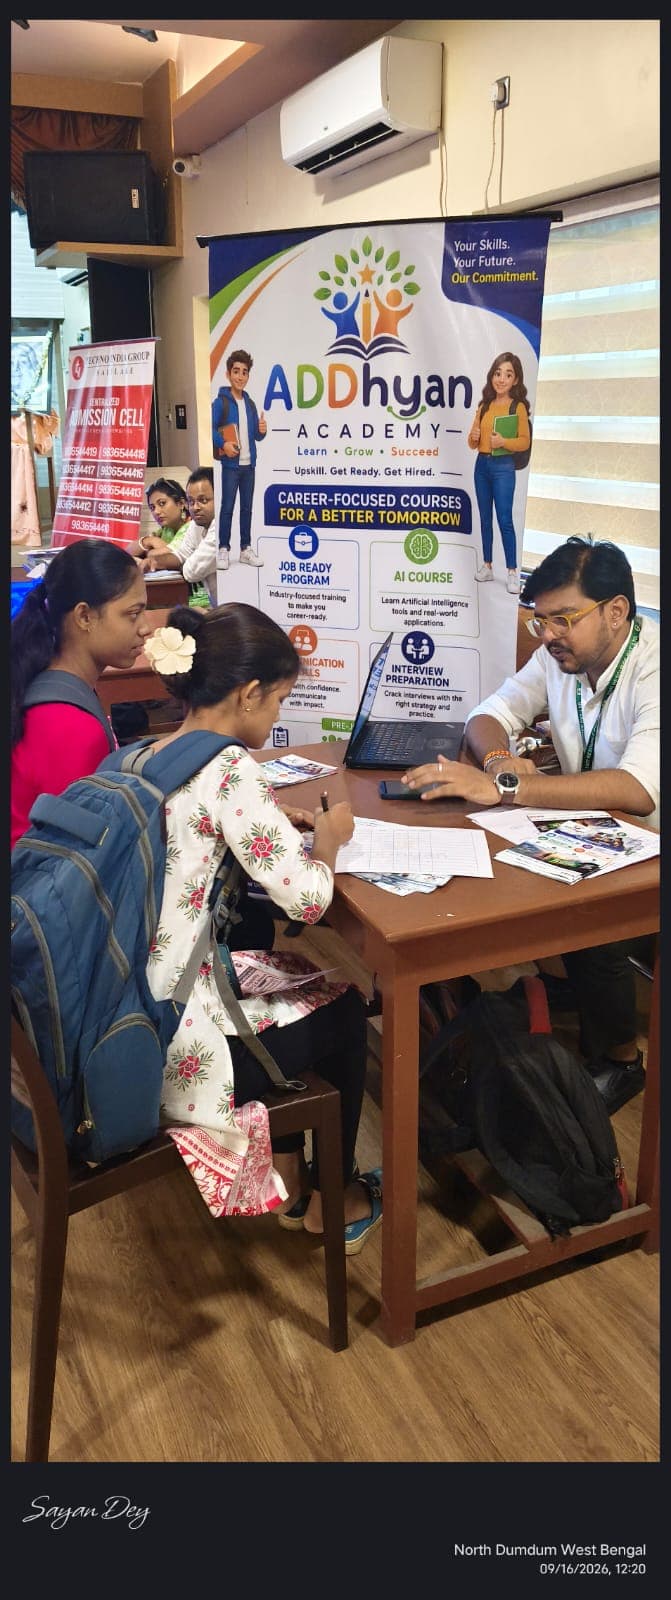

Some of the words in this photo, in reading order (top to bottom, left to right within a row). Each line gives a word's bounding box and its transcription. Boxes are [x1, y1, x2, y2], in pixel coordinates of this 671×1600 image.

[454, 240, 476, 251] Your
[479, 238, 511, 250] Skills.
[454, 257, 475, 268] Your
[478, 255, 516, 267] Future.
[451, 272, 470, 284] Our
[472, 270, 539, 283] Commitment.
[263, 362, 473, 417] ADDhyan
[119, 408, 145, 427] CELL
[297, 423, 441, 439] ACADEMY
[297, 446, 328, 457] Learn
[344, 446, 374, 457] Grow
[391, 446, 439, 457] Succeed
[294, 466, 327, 477] Upskill.
[330, 466, 347, 476] Get
[350, 466, 381, 478] Ready.
[384, 467, 402, 476] Get
[405, 467, 435, 477] Hired.
[278, 491, 396, 508] CAREER-FOCUSED
[400, 493, 462, 510] COURSES
[280, 508, 305, 521] FOR
[308, 508, 318, 522] A
[321, 509, 374, 523] BETTER
[378, 510, 461, 526] TOMORROW
[278, 560, 296, 572] JOB
[299, 561, 332, 573] READY
[280, 573, 330, 586] PROGRAM
[394, 570, 405, 582] AI
[408, 571, 454, 584] COURSE
[269, 590, 320, 601] Industry-focused
[322, 592, 347, 603] training
[381, 596, 400, 605] Learn
[402, 597, 430, 606] Artificial
[431, 598, 469, 610] Intelligence
[288, 602, 295, 610] to
[297, 602, 312, 610] make
[314, 604, 326, 612] you
[392, 607, 408, 616] tools
[410, 608, 422, 617] and
[424, 609, 458, 618] real-world
[286, 612, 328, 621] career-ready.
[403, 618, 446, 628] applications.
[391, 664, 444, 676] INTERVIEW
[386, 675, 450, 688] PREPARATION
[307, 684, 342, 693] confidence.
[384, 690, 402, 699] Crack
[403, 692, 437, 701] interviews
[438, 693, 451, 702] with
[452, 694, 463, 703] the
[395, 701, 410, 710] right
[411, 702, 436, 712] strategy
[438, 703, 451, 711] and
[408, 709, 436, 719] practice.
